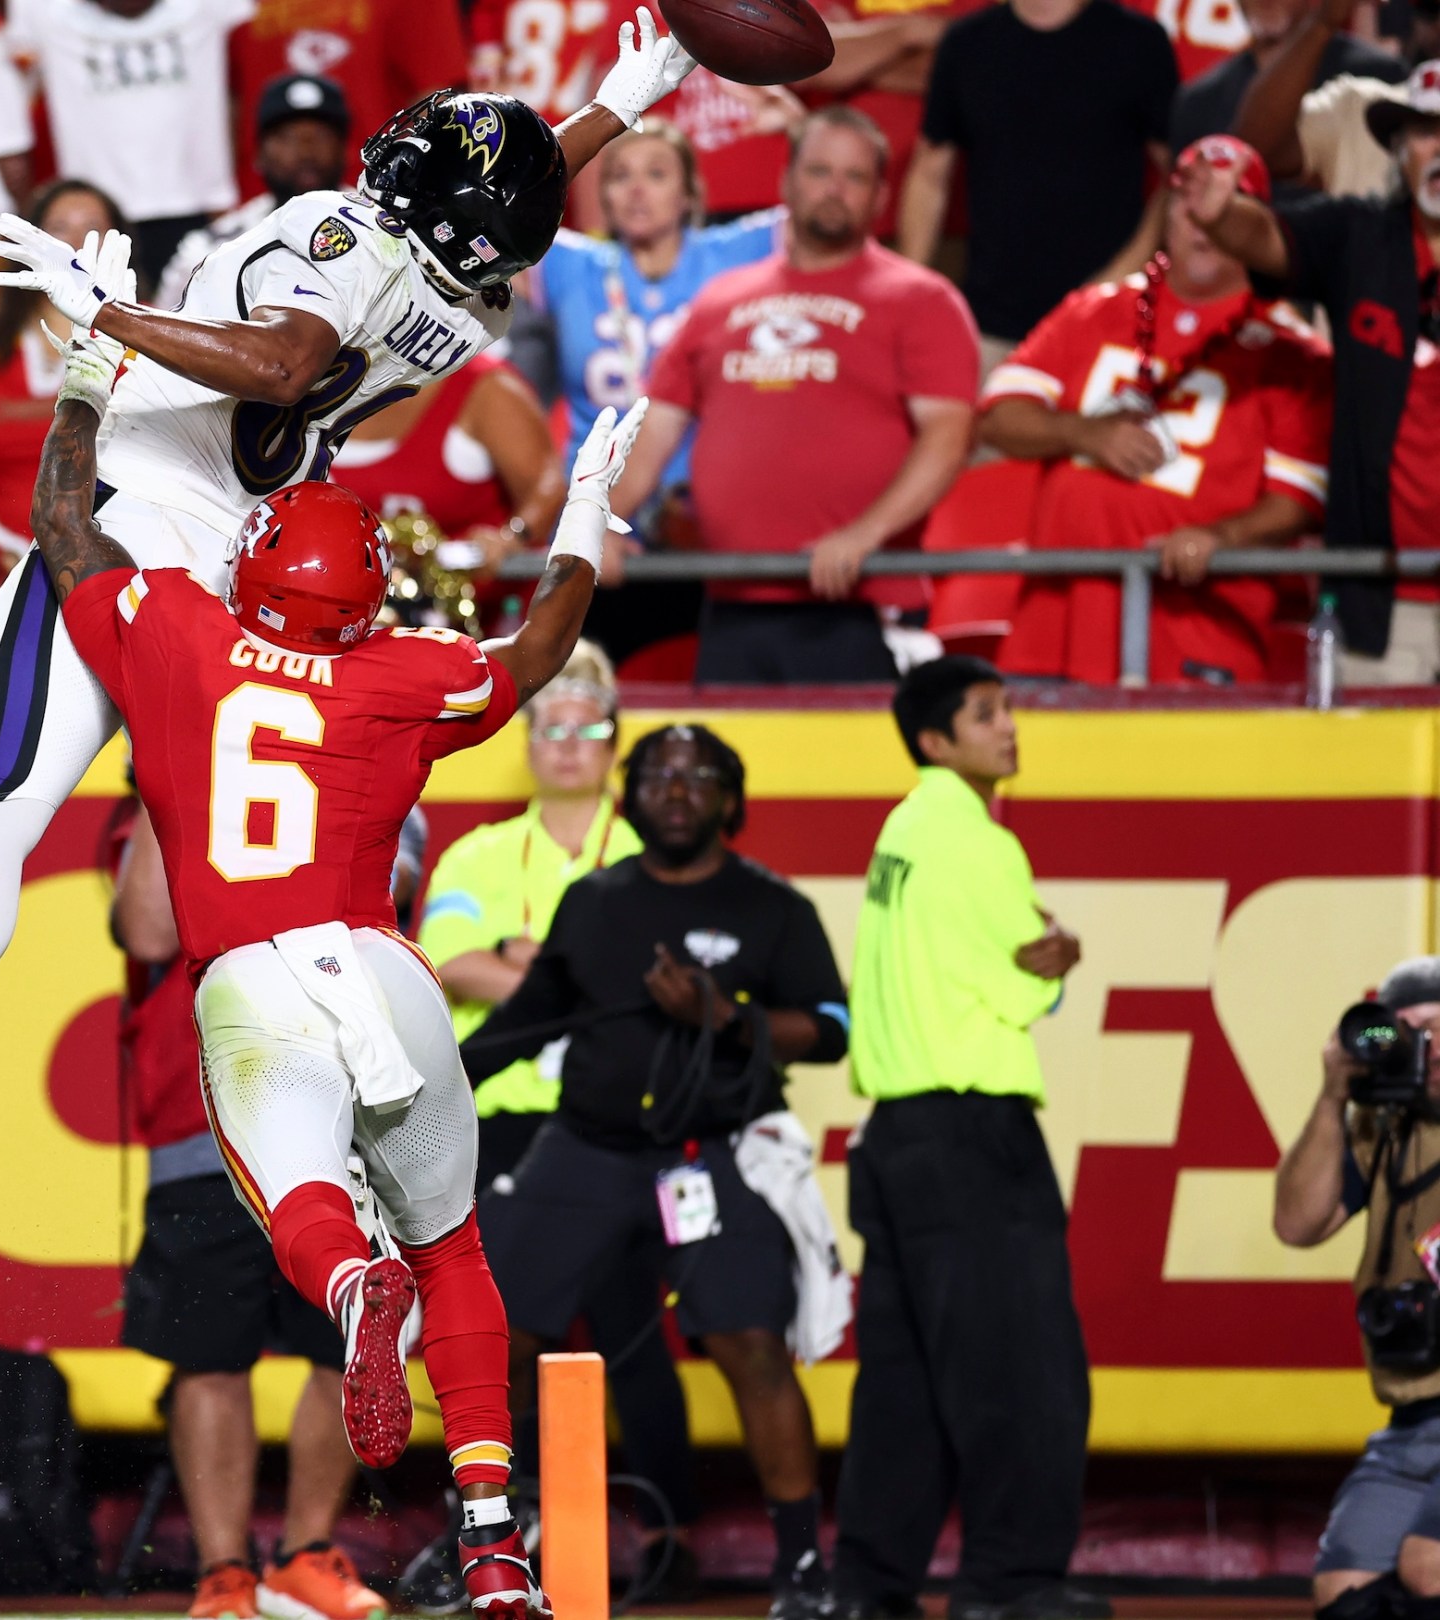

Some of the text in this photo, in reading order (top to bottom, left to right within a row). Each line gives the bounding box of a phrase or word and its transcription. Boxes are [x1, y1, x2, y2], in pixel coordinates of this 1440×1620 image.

[328, 218, 356, 244] RAVENS
[382, 300, 473, 376] LIKELY
[228, 638, 334, 688] COOK
[207, 680, 326, 883] 6
